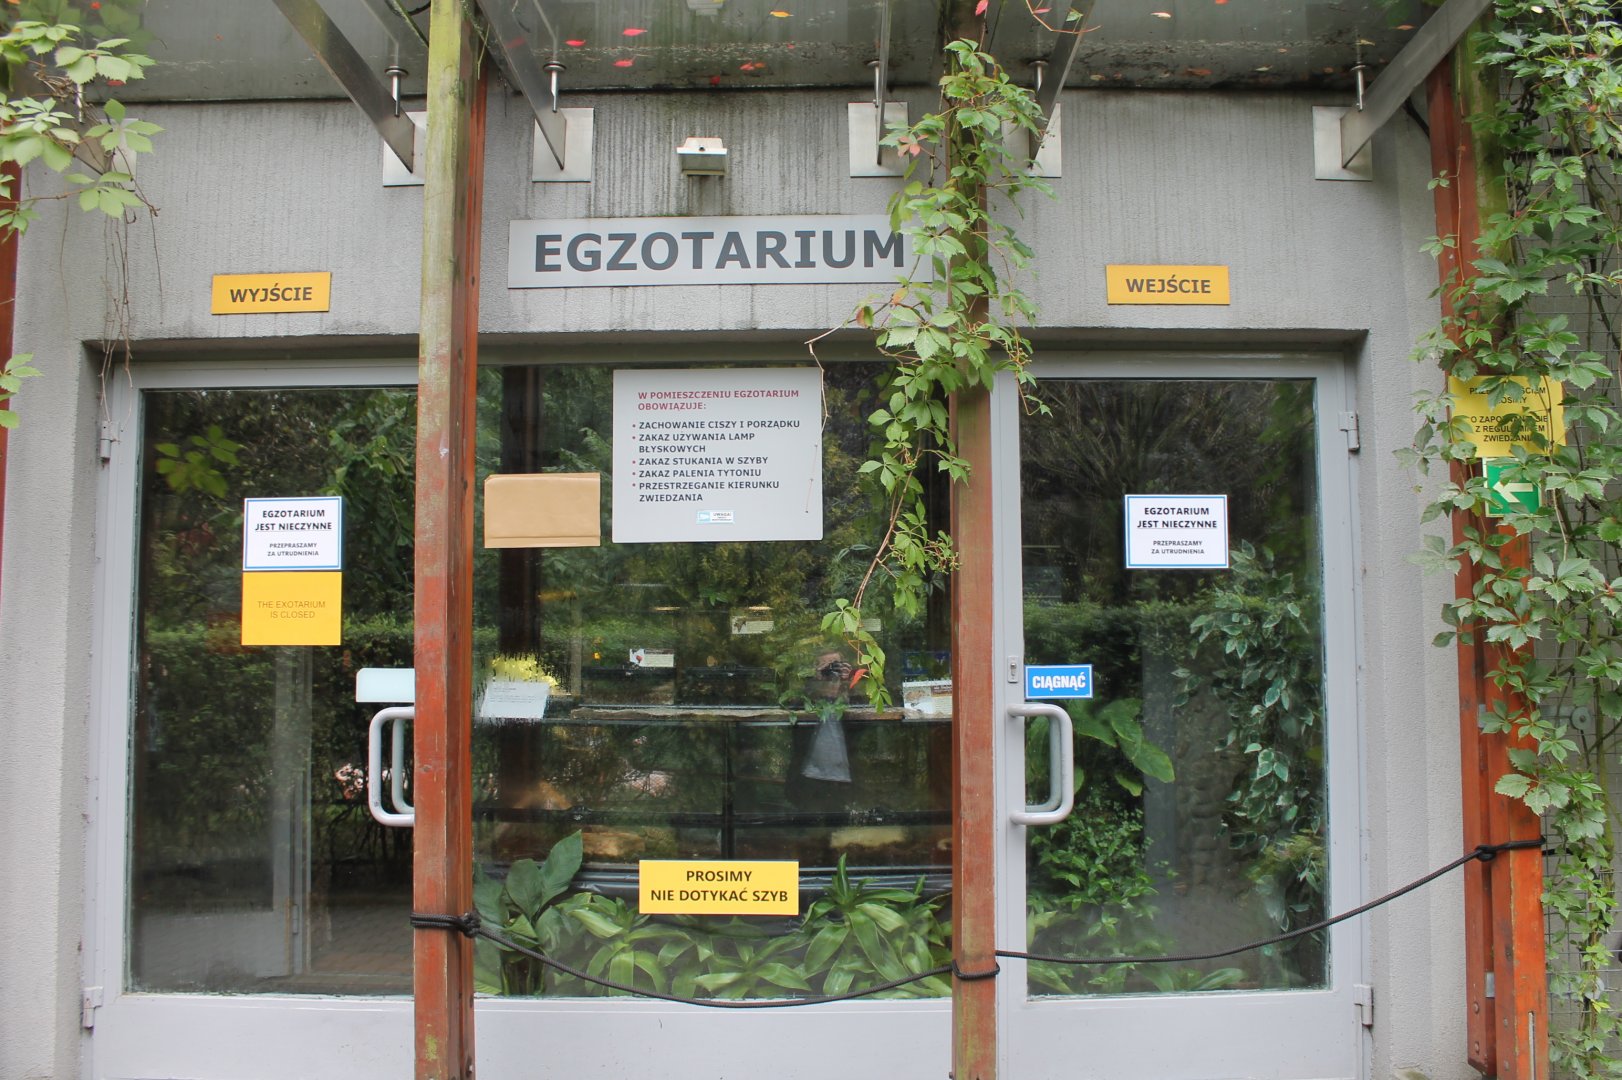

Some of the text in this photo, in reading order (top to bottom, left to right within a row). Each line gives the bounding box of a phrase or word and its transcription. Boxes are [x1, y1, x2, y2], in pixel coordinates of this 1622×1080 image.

[535, 229, 904, 273] EGZOTARIUM
[1125, 274, 1211, 294] WEJŚCIE
[229, 282, 313, 303] WYJŚCIE
[638, 390, 799, 400] W POMIESZCZENIU EGZOTARIUM
[638, 402, 707, 412] OBOWIĄZUJE:
[1470, 415, 1477, 424] O
[639, 420, 705, 430] ZACHOWANIE
[708, 420, 737, 429] CISZY
[747, 420, 800, 430] PORZĄDKU
[1475, 425, 1481, 433] Z
[639, 433, 670, 442] ZAKAZ
[728, 432, 755, 441] LAMP
[639, 445, 706, 454] BŁYSKOWYCH
[639, 456, 768, 466] ZAKAZ STUKANIA W SZYBY
[639, 469, 762, 478] ZAKAZ PALENIA TYTONIU
[639, 481, 780, 490] PRZESTRZEGANIE KIERUNKU
[639, 493, 703, 502] ZWIEDZANIA
[262, 509, 325, 518] EGZOTARIUM
[1144, 507, 1210, 515] EGZOTARIUM
[255, 522, 332, 531] JEST NIECZYNNE
[1137, 520, 1217, 528] JEST NIECZYNNE
[258, 600, 326, 609] THE EXOTARIUM
[280, 611, 315, 619] CLOSED
[1032, 672, 1086, 691] CIĄGNĄĆ
[686, 870, 753, 882] PROSIMY
[650, 887, 788, 902] NIE DOTYKAĆ SZYB
